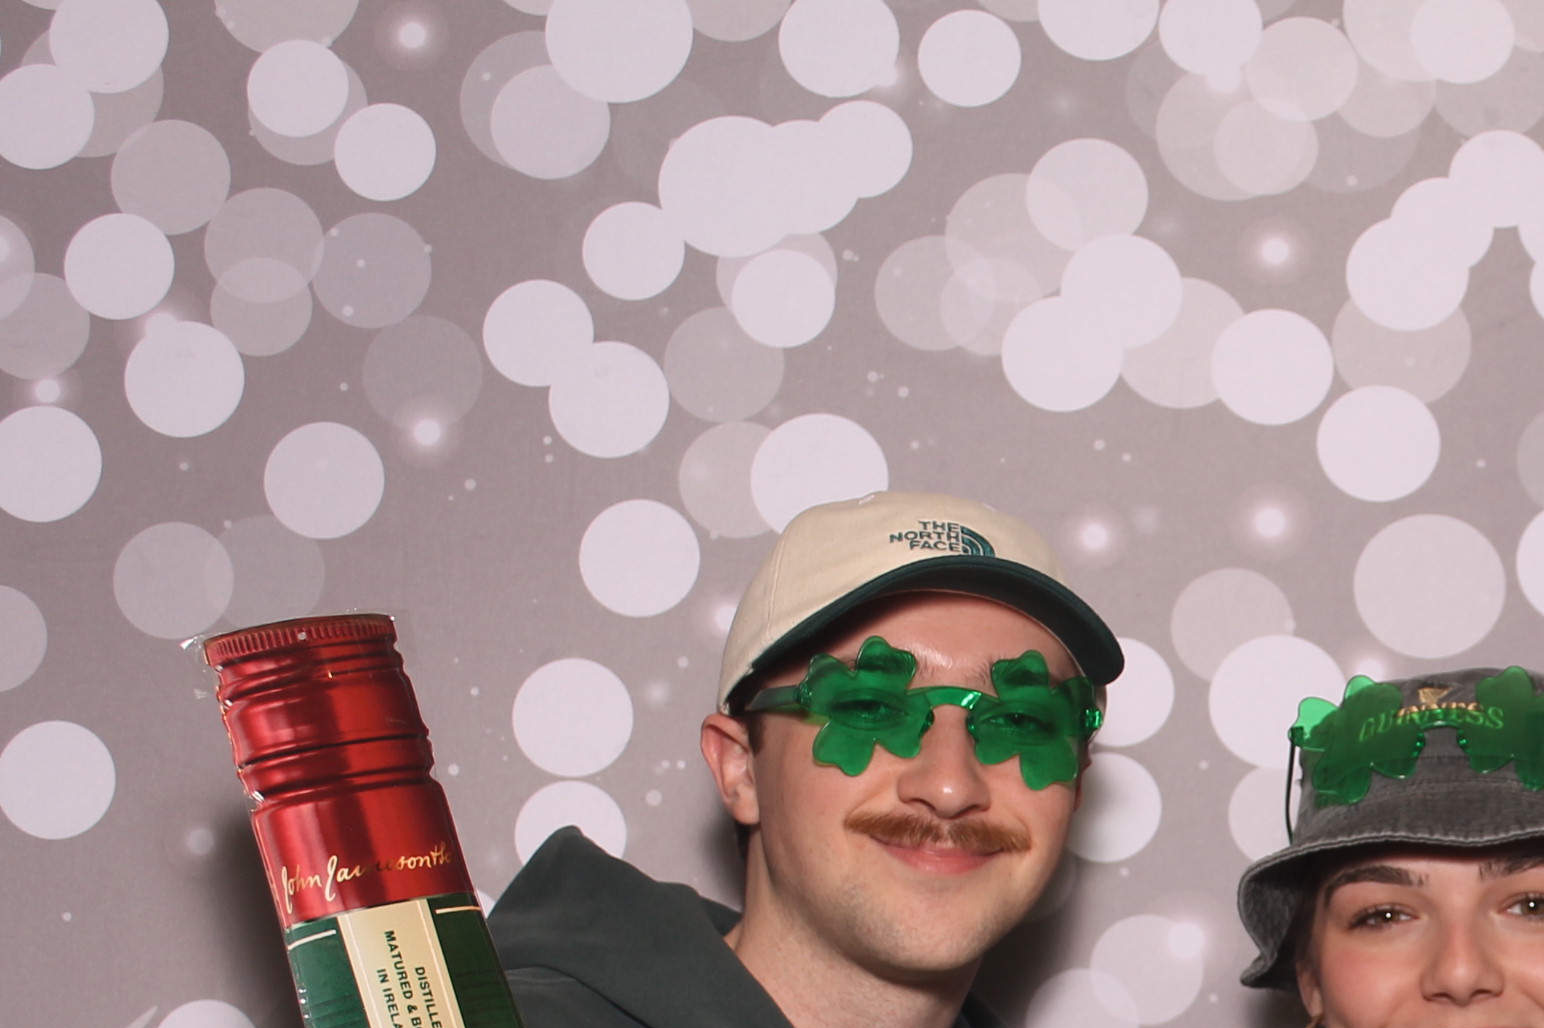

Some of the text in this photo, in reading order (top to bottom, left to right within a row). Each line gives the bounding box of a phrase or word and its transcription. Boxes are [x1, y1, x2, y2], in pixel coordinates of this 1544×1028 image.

[918, 520, 959, 532] THE
[889, 531, 960, 544] NORTH
[909, 540, 961, 553] FACE
[377, 968, 389, 984] IN
[384, 930, 413, 1000] MATURED
[407, 1004, 418, 1014] &
